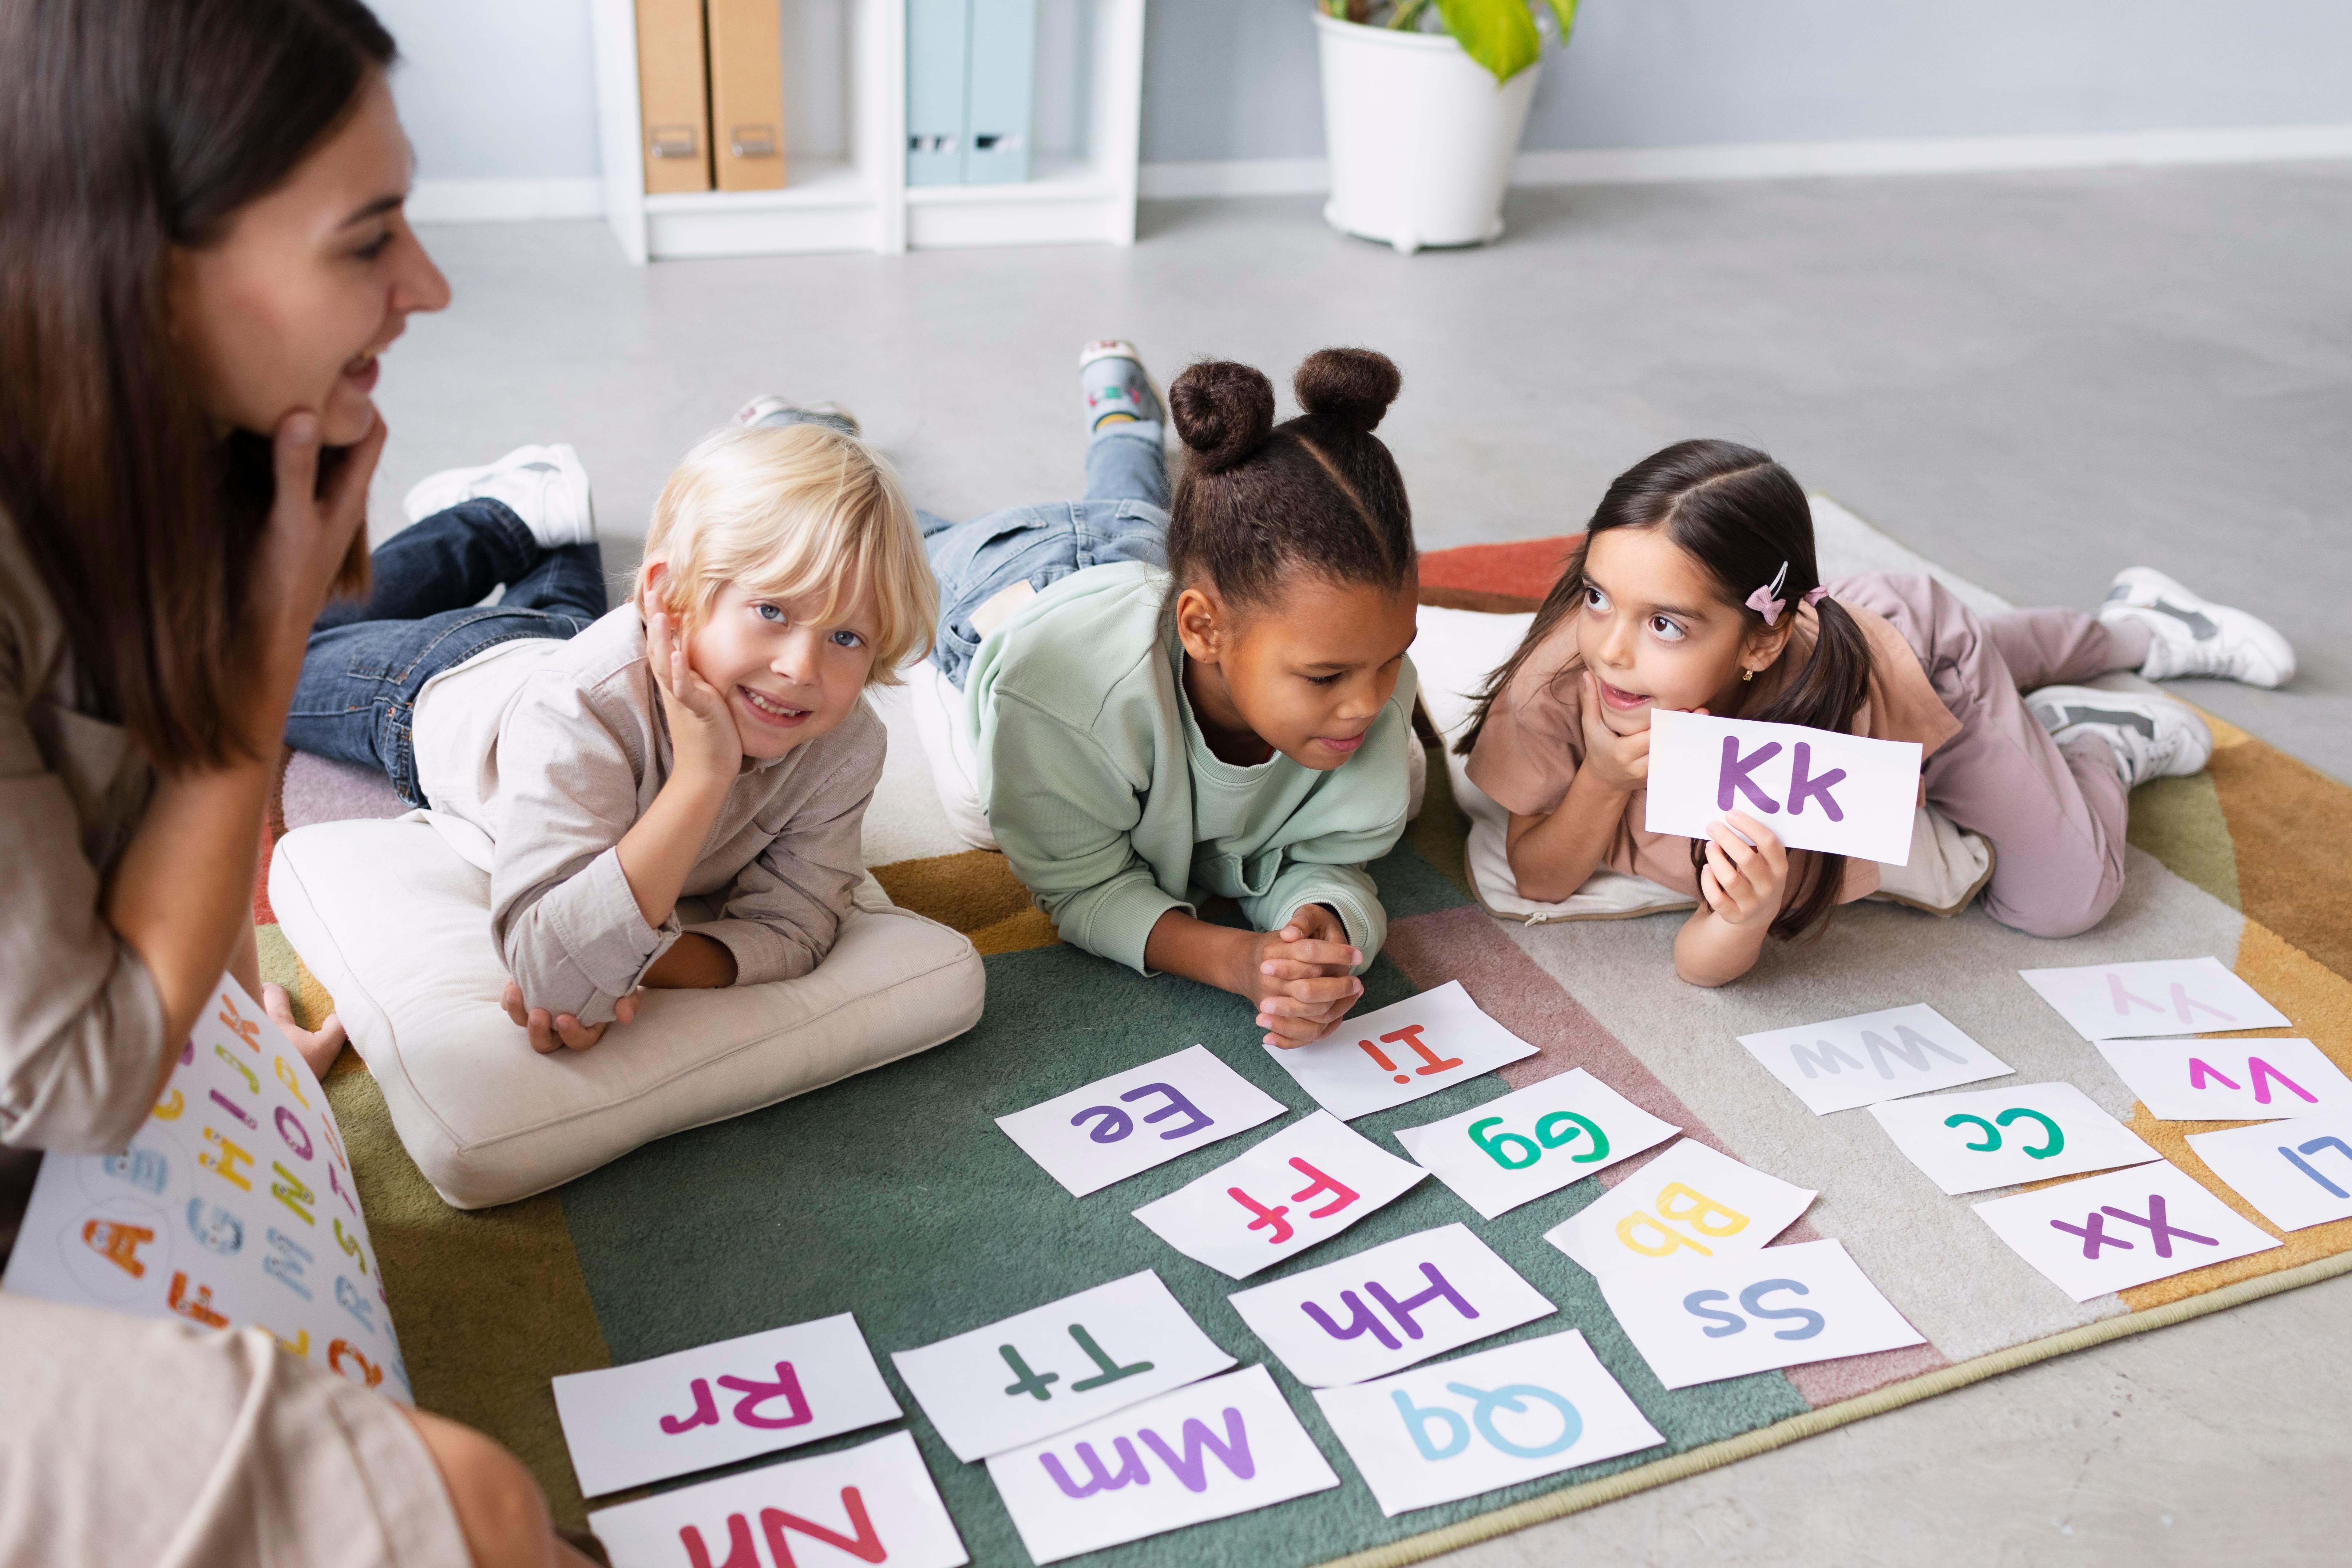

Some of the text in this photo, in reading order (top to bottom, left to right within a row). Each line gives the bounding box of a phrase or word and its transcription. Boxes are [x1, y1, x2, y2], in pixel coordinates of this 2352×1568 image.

[1717, 736, 1846, 822] Kk
[219, 994, 260, 1053] K
[1358, 1024, 1463, 1084] Ii
[272, 1105, 313, 1161] O
[1070, 1082, 1215, 1144] Ee
[1468, 1110, 1610, 1170] Gg
[1944, 1108, 2064, 1160] Cc
[198, 1126, 257, 1192] H
[328, 1160, 357, 1216] T
[271, 1160, 315, 1226] N
[1227, 1157, 1360, 1243] Ff
[1616, 1182, 1750, 1257] Bb
[82, 1219, 155, 1279] A
[333, 1217, 367, 1275] S
[2050, 1194, 2219, 1259] Xx
[263, 1227, 314, 1301] M
[167, 1271, 229, 1330] F
[1300, 1262, 1480, 1349] Hh
[1683, 1279, 1825, 1341] Ss
[998, 1324, 1155, 1401] Tt
[659, 1361, 813, 1434] Rr
[1390, 1382, 1583, 1462] Qq
[1038, 1407, 1255, 1498] Mm
[678, 1485, 887, 1568] Nn
